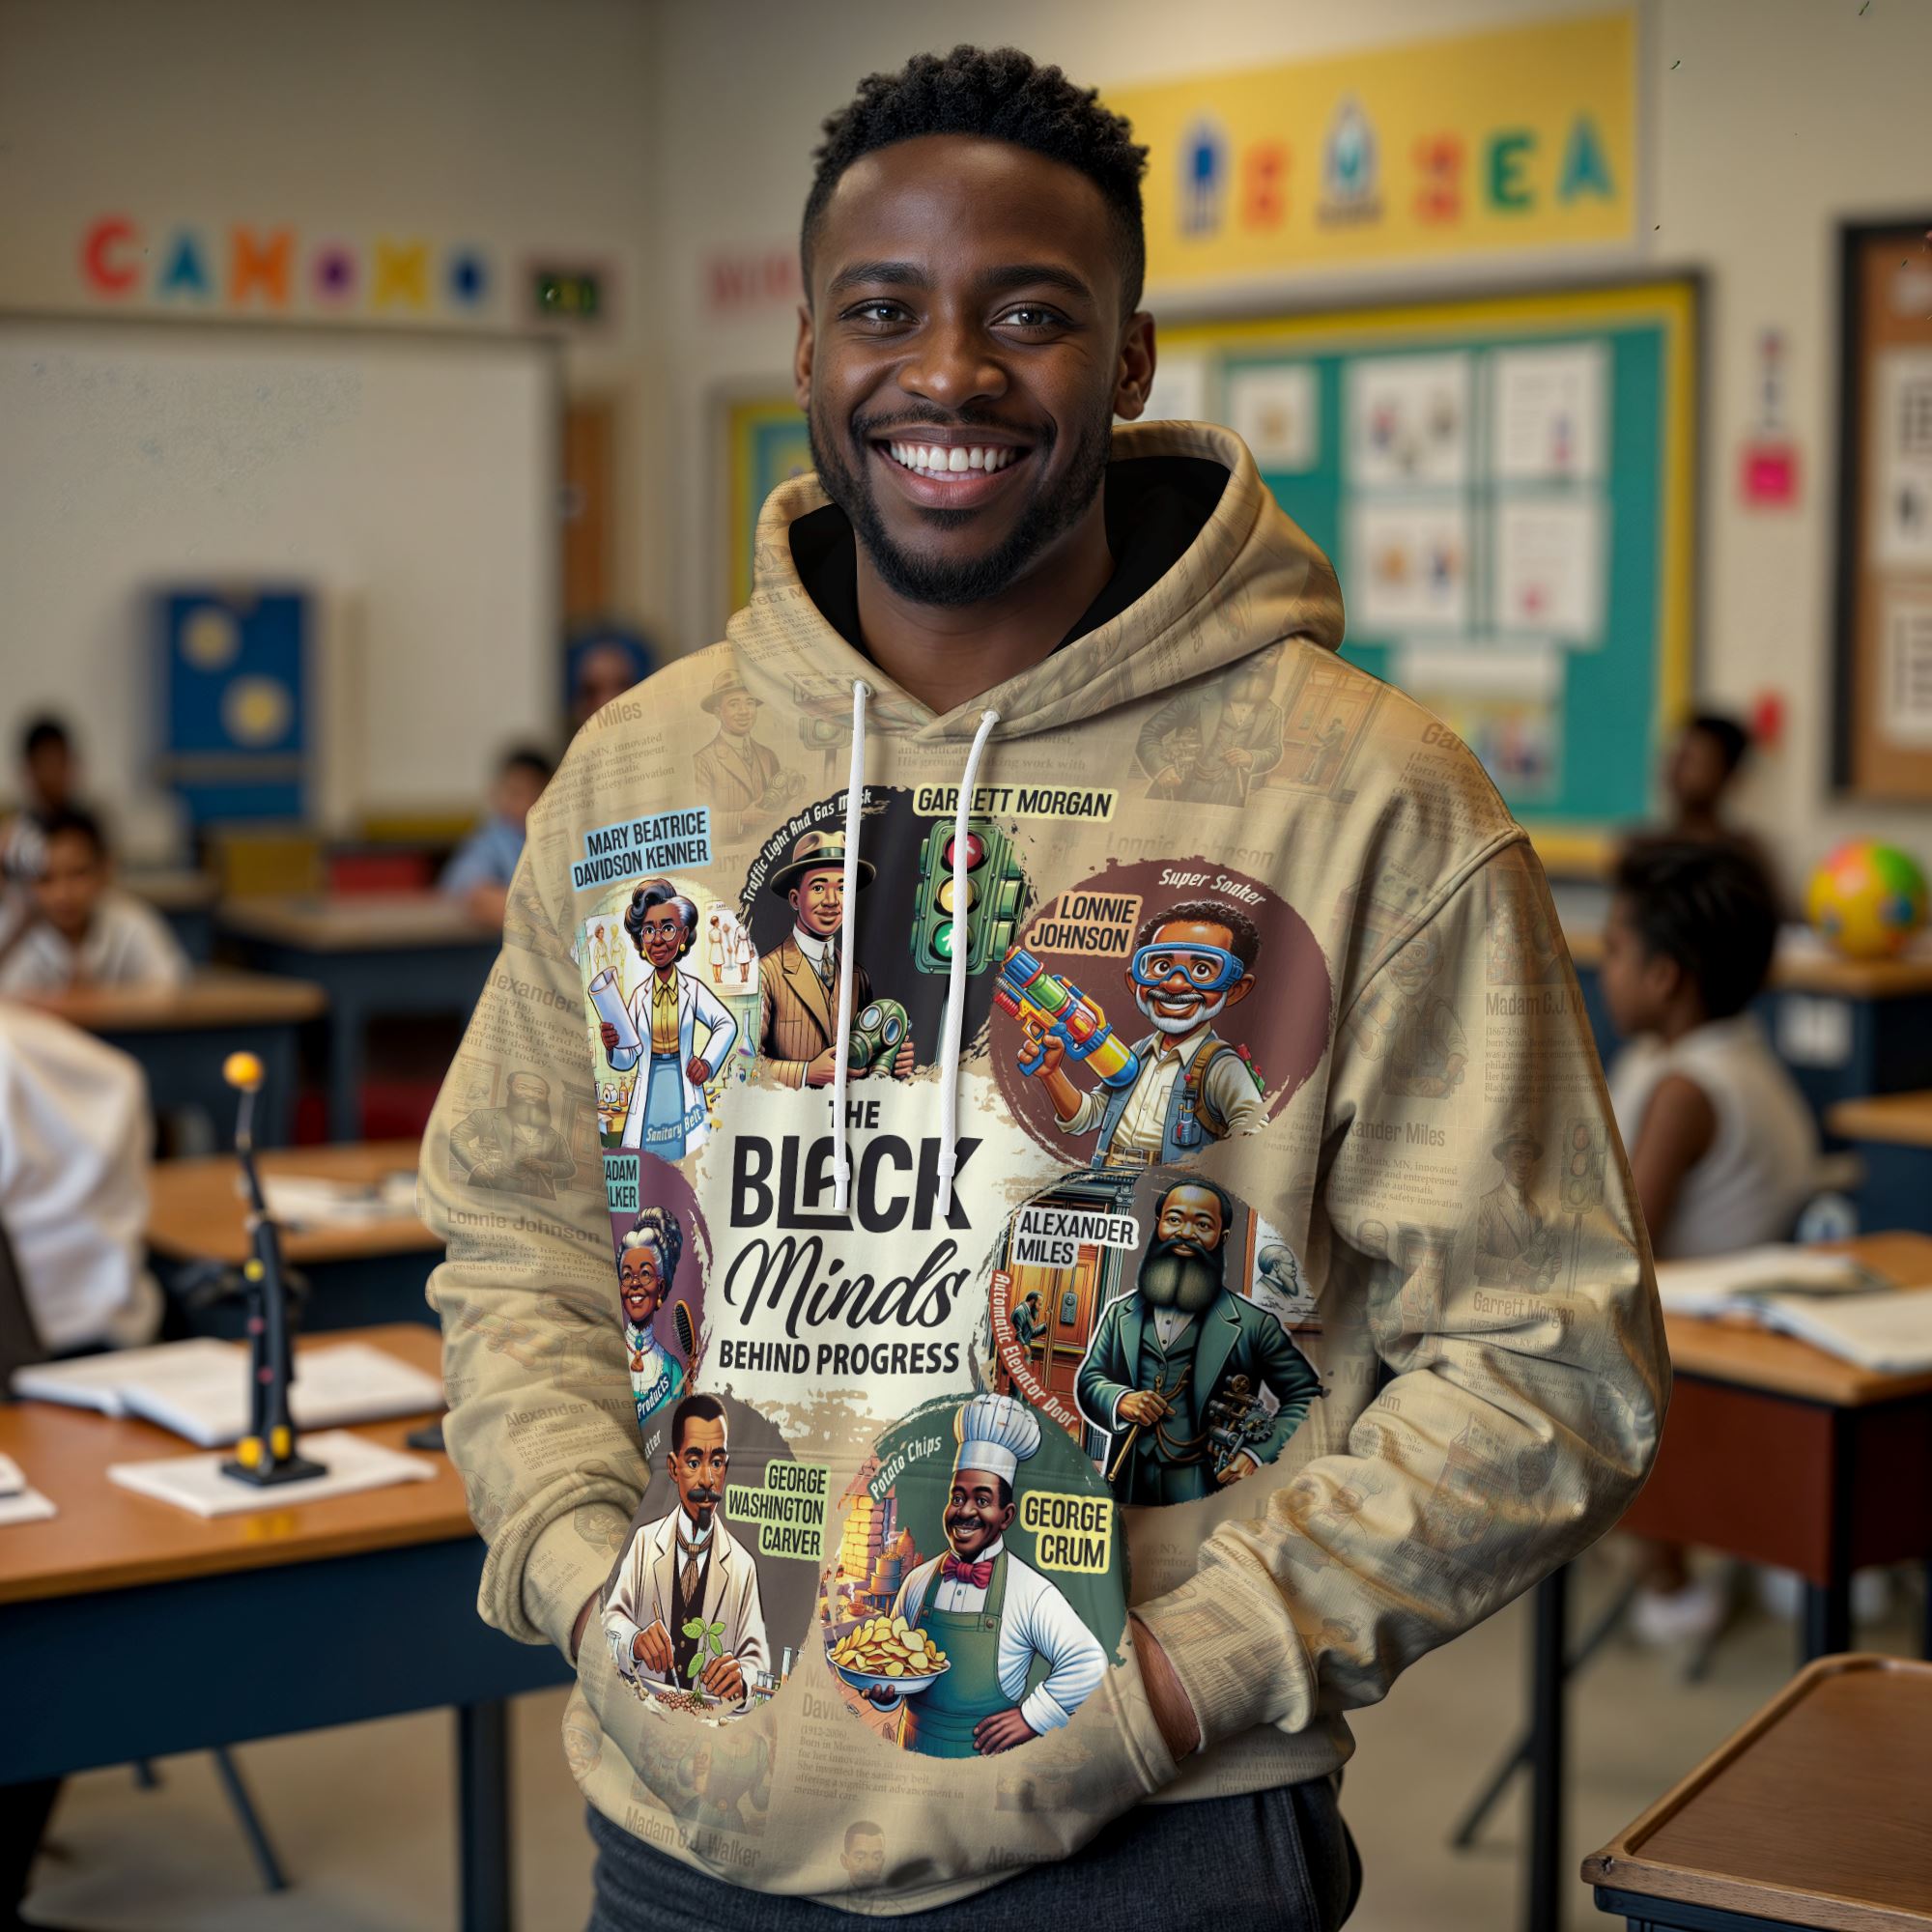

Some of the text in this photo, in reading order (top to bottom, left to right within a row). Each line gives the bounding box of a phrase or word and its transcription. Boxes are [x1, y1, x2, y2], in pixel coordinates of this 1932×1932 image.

[596, 701, 642, 730] Miles
[1022, 758, 1053, 769] work
[1057, 759, 1087, 771] with
[918, 787, 1113, 818] GARETT MORGAN
[586, 810, 707, 858] MARY BEATRICE
[574, 850, 643, 888] DAVIDSON
[645, 838, 708, 870] KENNER
[743, 858, 769, 902] Traffic
[763, 829, 791, 863] Light
[788, 811, 812, 838] And
[813, 802, 835, 822] Gas
[1158, 868, 1267, 906] Super Soaker
[1060, 895, 1137, 923] LONNIE
[1030, 923, 1129, 952] JOHNSON
[486, 968, 581, 1013] lexander
[1485, 992, 1540, 1016] Madam
[645, 1108, 702, 1143] Sanitary Belt
[1406, 1122, 1446, 1148] Miles
[603, 1158, 638, 1182] ADAM
[1344, 1165, 1386, 1178] inventor
[1385, 1170, 1401, 1179] and
[1393, 1159, 1413, 1171] MN,
[1414, 1161, 1459, 1176] innovated
[606, 1185, 638, 1208] LKER
[728, 1133, 983, 1234] BLACK
[1376, 1179, 1391, 1189] the
[1392, 1182, 1435, 1196] automatic
[1361, 1199, 1390, 1211] today.
[1388, 1191, 1416, 1206] safety
[1417, 1195, 1463, 1209] innovation
[447, 1207, 602, 1244] Lonnie Johnson
[1019, 1210, 1134, 1245] ALEXANDER
[538, 1246, 557, 1255] his
[1015, 1237, 1074, 1265] MILES
[452, 1264, 493, 1273] product
[508, 1264, 529, 1273] the
[530, 1267, 549, 1277] toy
[723, 1235, 972, 1341] Minds
[1472, 1291, 1576, 1329] Garrett Morgan
[718, 1339, 961, 1376] BEHIND PROGRESS
[993, 1273, 1079, 1429] Automatic Elevator Door
[636, 1375, 669, 1419] Products
[504, 1401, 588, 1429] Alexander
[767, 1464, 827, 1494] GEORGE
[869, 1435, 943, 1501] Potato Chips
[727, 1489, 825, 1525] WASHINGTON
[1023, 1496, 1109, 1533] GEORGE
[761, 1524, 822, 1557] CARVER
[1039, 1532, 1106, 1569] CRUM
[799, 1737, 820, 1748] Born
[795, 1773, 832, 1789] offering
[797, 1761, 813, 1772] She
[815, 1763, 854, 1776] invented
[855, 1767, 869, 1778] the
[624, 1805, 675, 1847] Madam
[707, 1832, 762, 1869] Walker
